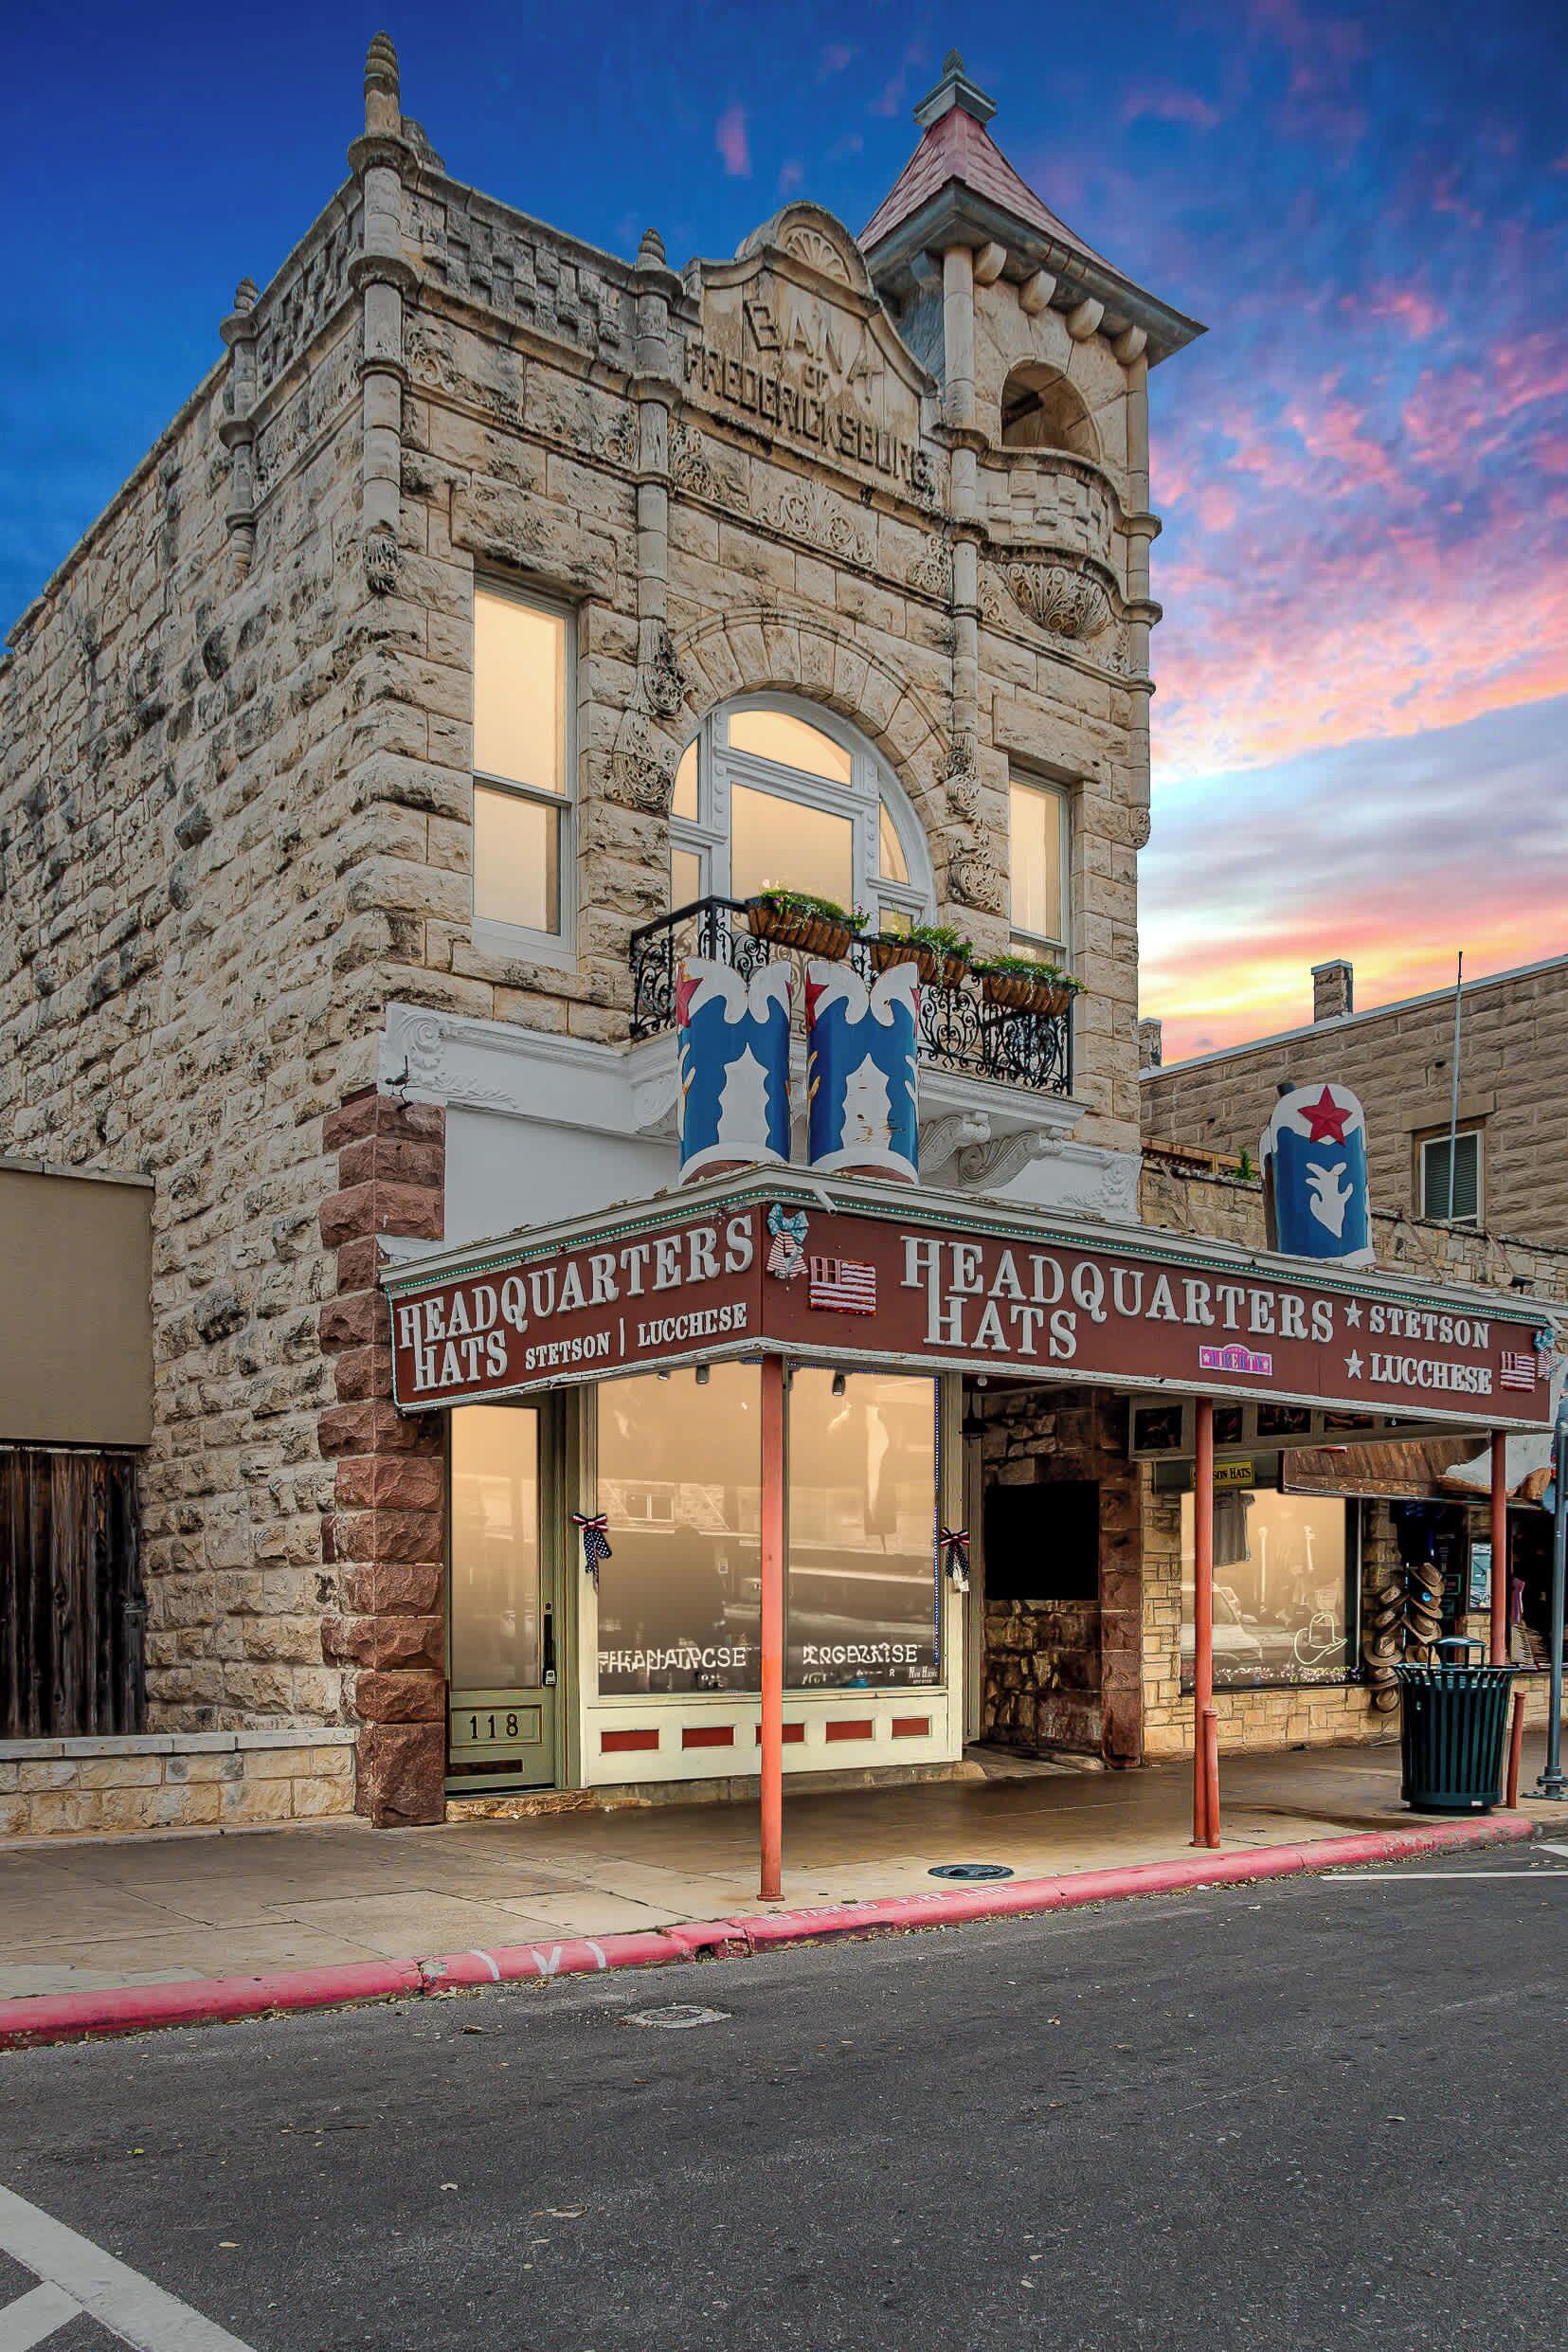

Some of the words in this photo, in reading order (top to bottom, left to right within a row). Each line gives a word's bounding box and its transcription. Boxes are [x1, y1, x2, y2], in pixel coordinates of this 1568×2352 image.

[397, 1215, 753, 1349] HEADQUARTERS
[900, 1235, 1334, 1344] HEADQUARTERS
[525, 1331, 612, 1370] STETSON
[638, 1302, 748, 1347] LUCCHESE
[923, 1295, 1077, 1360] HATS
[1369, 1305, 1490, 1348] STETSON
[412, 1329, 508, 1393] HATS
[1370, 1353, 1493, 1395] LUCCHESE
[1230, 1467, 1252, 1479] HATS
[470, 1712, 519, 1739] 118
